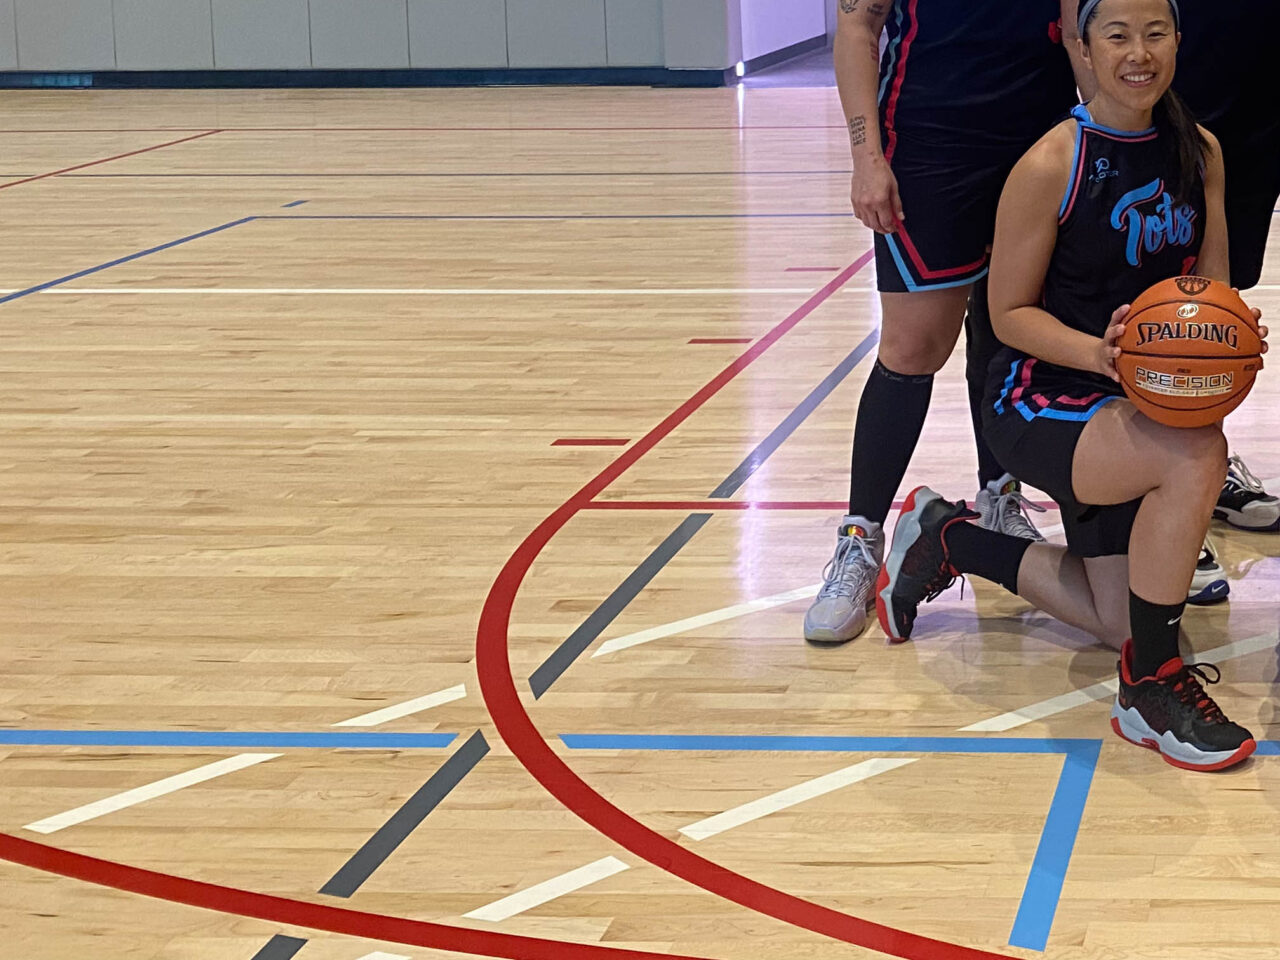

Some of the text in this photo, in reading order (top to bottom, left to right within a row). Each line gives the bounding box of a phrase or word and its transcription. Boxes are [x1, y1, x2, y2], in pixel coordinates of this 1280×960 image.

[1110, 178, 1198, 268] Tots
[1136, 321, 1239, 351] SPALDING
[1135, 365, 1235, 390] PRECISION
